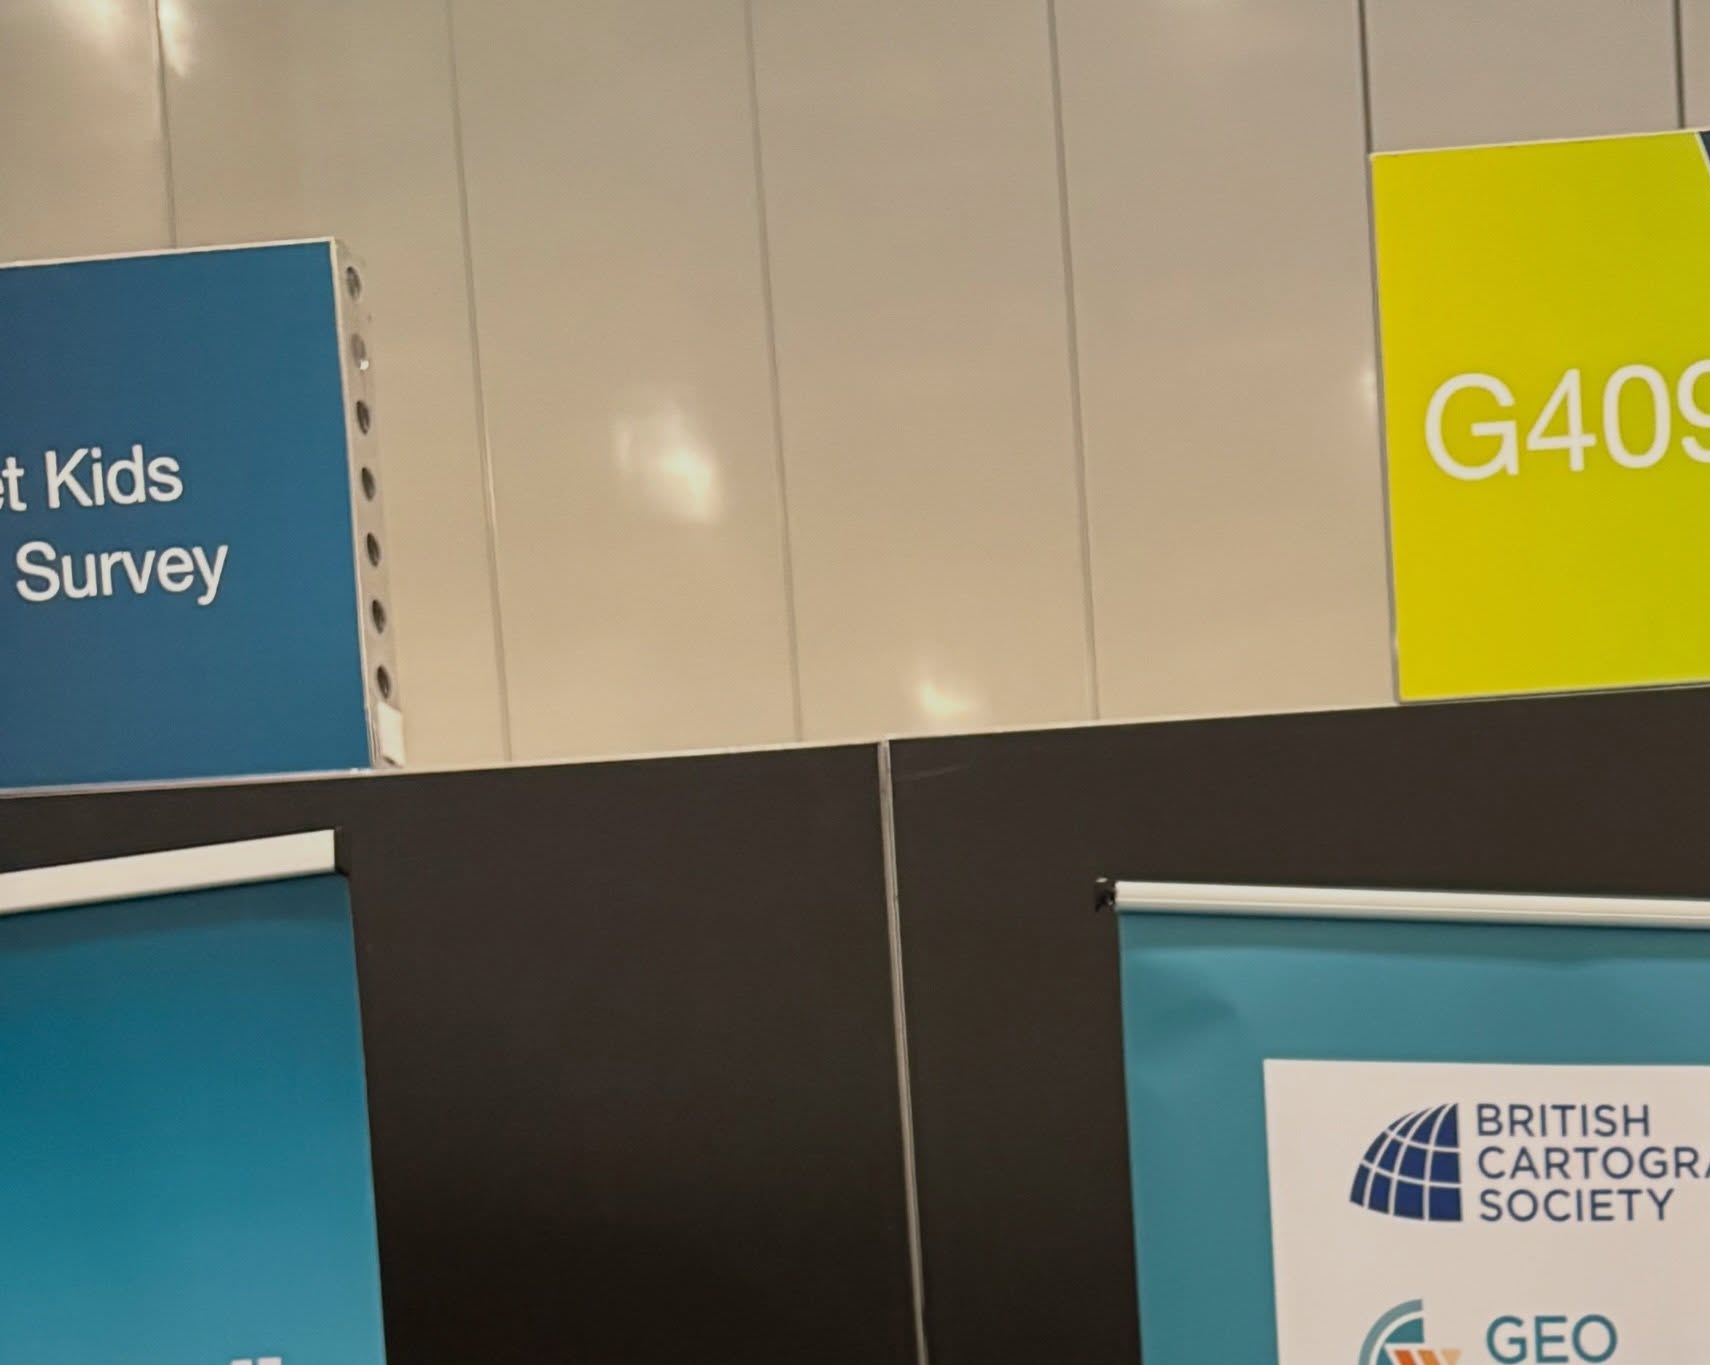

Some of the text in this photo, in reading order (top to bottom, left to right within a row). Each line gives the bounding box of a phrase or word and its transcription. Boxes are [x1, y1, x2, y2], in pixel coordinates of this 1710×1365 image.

[45, 445, 184, 509] Kids
[15, 541, 229, 606] Survey
[1476, 1103, 1652, 1138] BRITISH
[1479, 1188, 1676, 1223] SOCIETY
[1486, 1314, 1619, 1365] GEO
